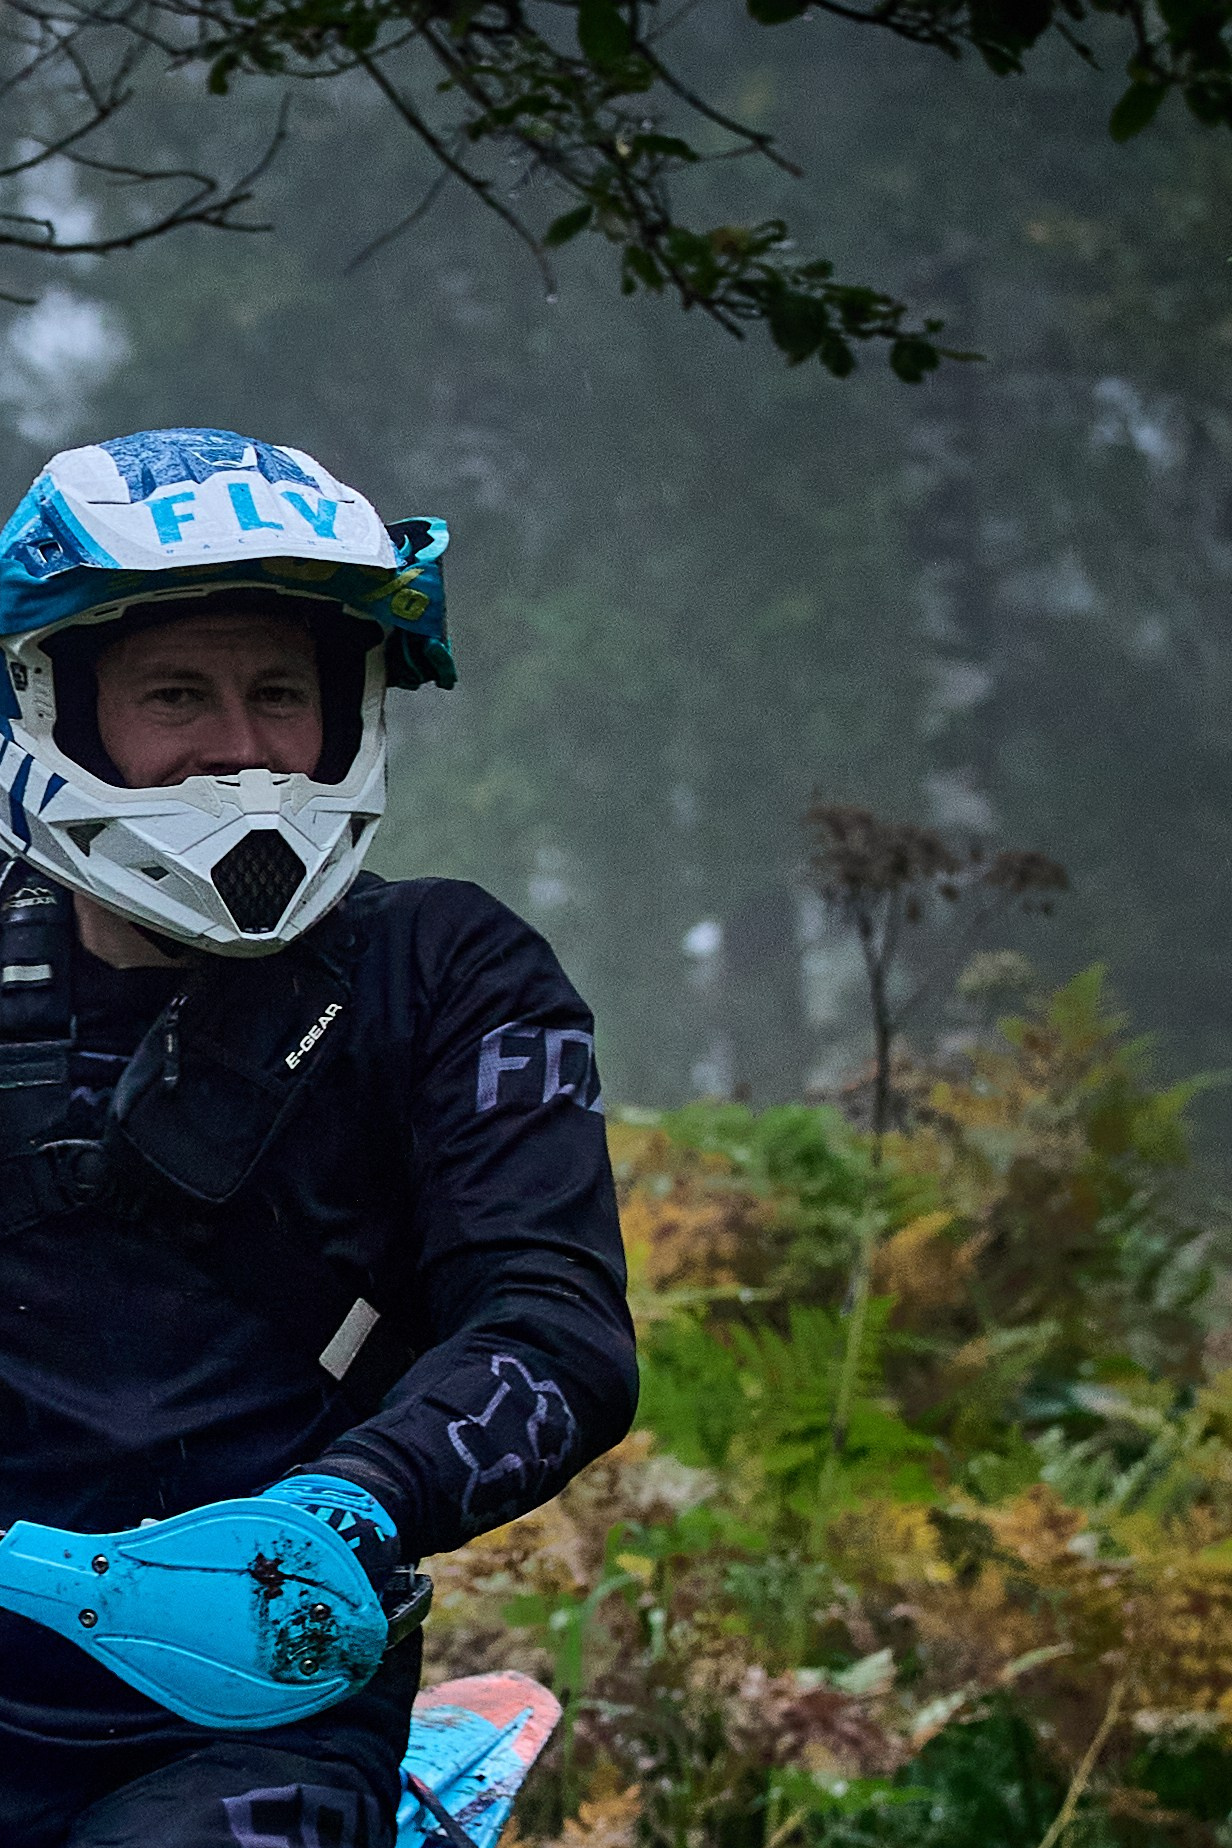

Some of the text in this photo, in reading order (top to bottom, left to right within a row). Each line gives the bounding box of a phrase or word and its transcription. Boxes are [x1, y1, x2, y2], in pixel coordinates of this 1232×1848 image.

[144, 482, 338, 546] FLY
[284, 1003, 343, 1070] E-GEAR
[475, 1021, 604, 1114] FO
